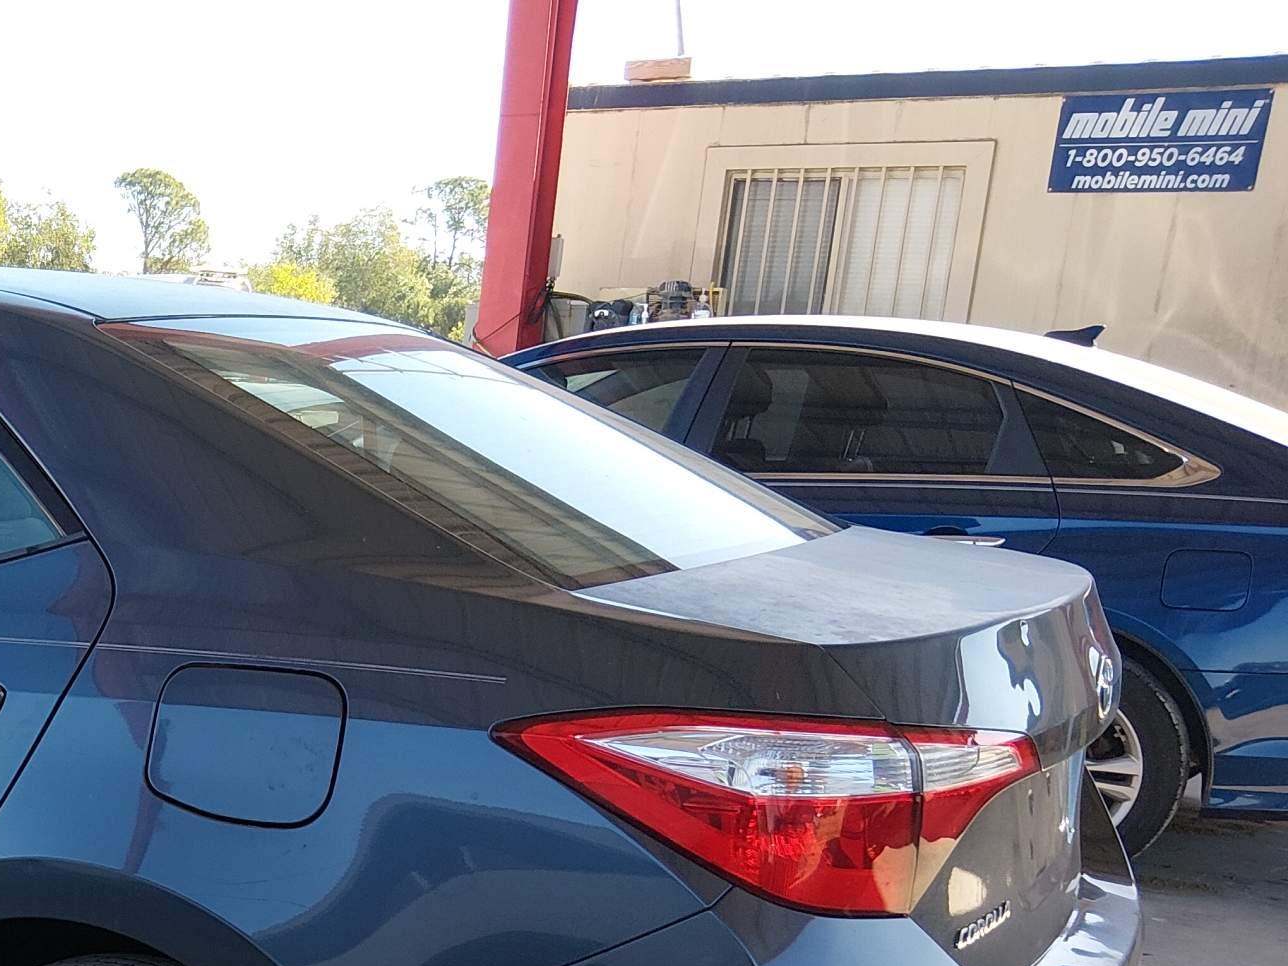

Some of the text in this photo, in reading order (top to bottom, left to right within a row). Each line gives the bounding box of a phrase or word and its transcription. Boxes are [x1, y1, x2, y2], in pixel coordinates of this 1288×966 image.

[1062, 97, 1265, 138] mobile mini
[1065, 146, 1246, 168] 1-800-950-6464
[1071, 170, 1230, 190] mobilemini.com
[954, 900, 1010, 949] COROLLA
